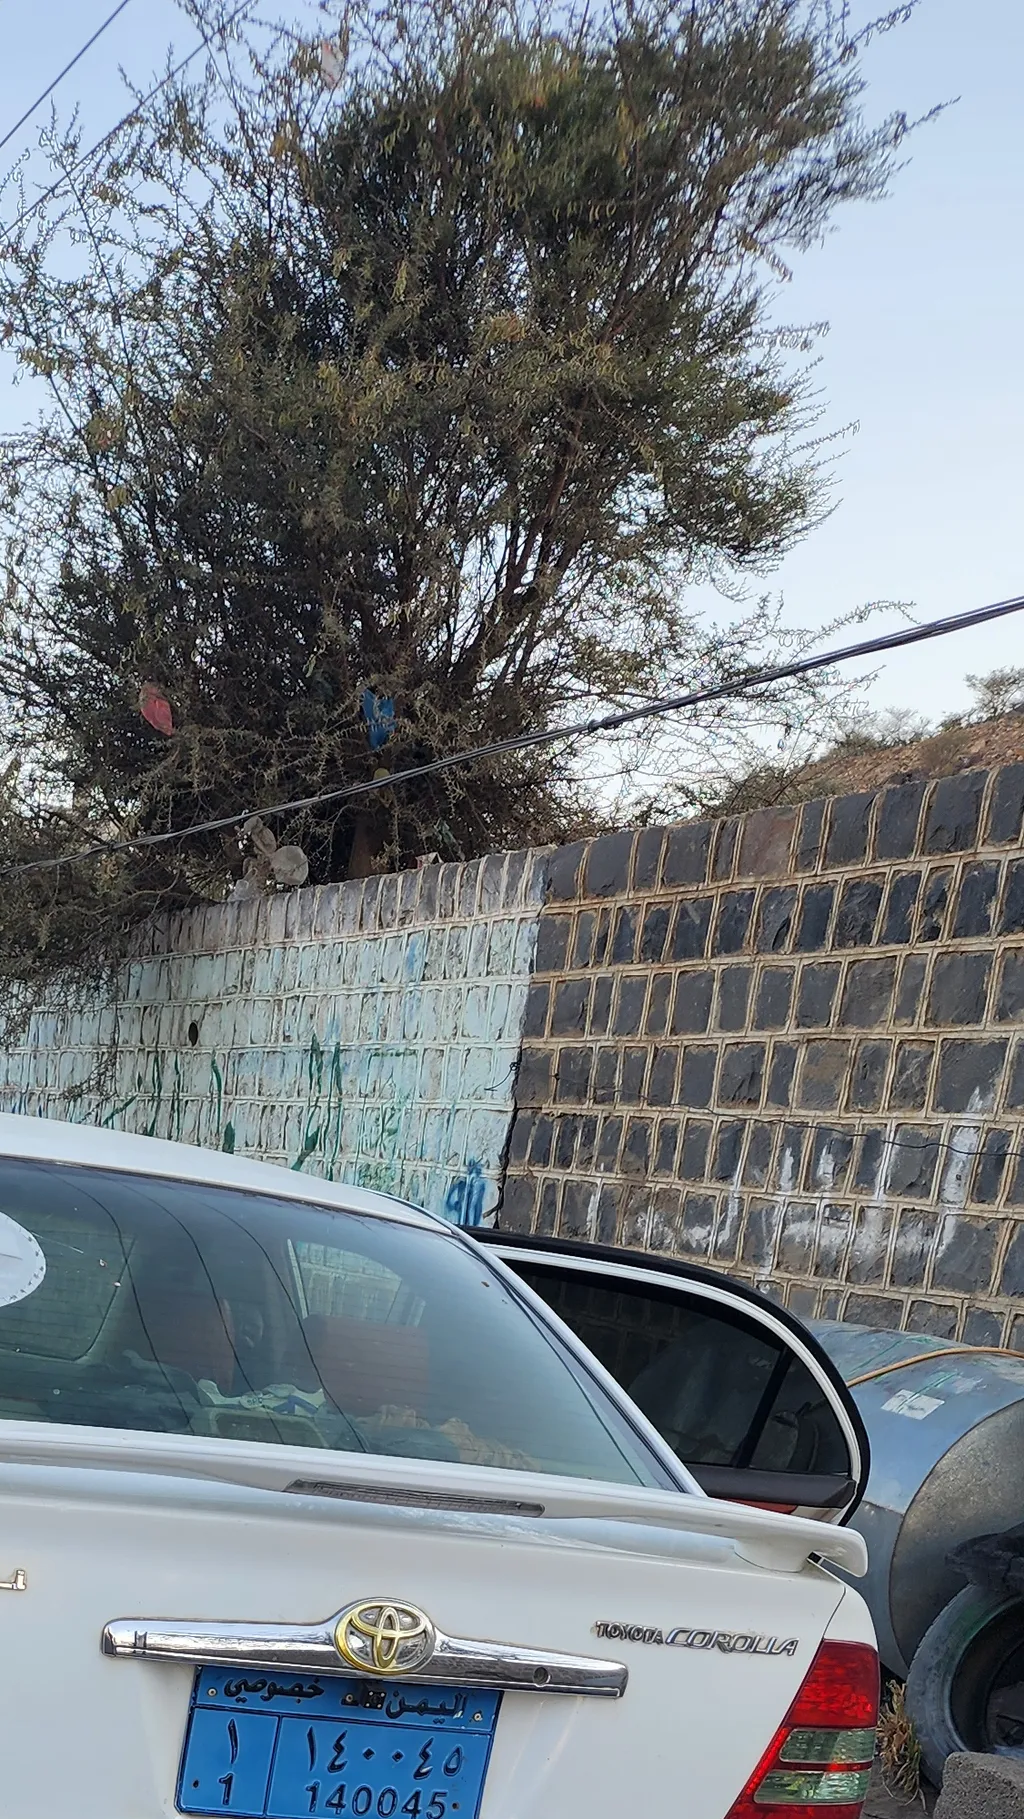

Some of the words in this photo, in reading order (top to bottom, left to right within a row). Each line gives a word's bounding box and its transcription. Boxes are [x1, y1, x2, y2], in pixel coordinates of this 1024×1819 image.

[596, 1620, 664, 1645] TOYOTA
[665, 1627, 800, 1656] COROLLA
[223, 1676, 325, 1704] خصوصي
[385, 1690, 469, 1724] اليمن
[218, 1772, 233, 1806] 1
